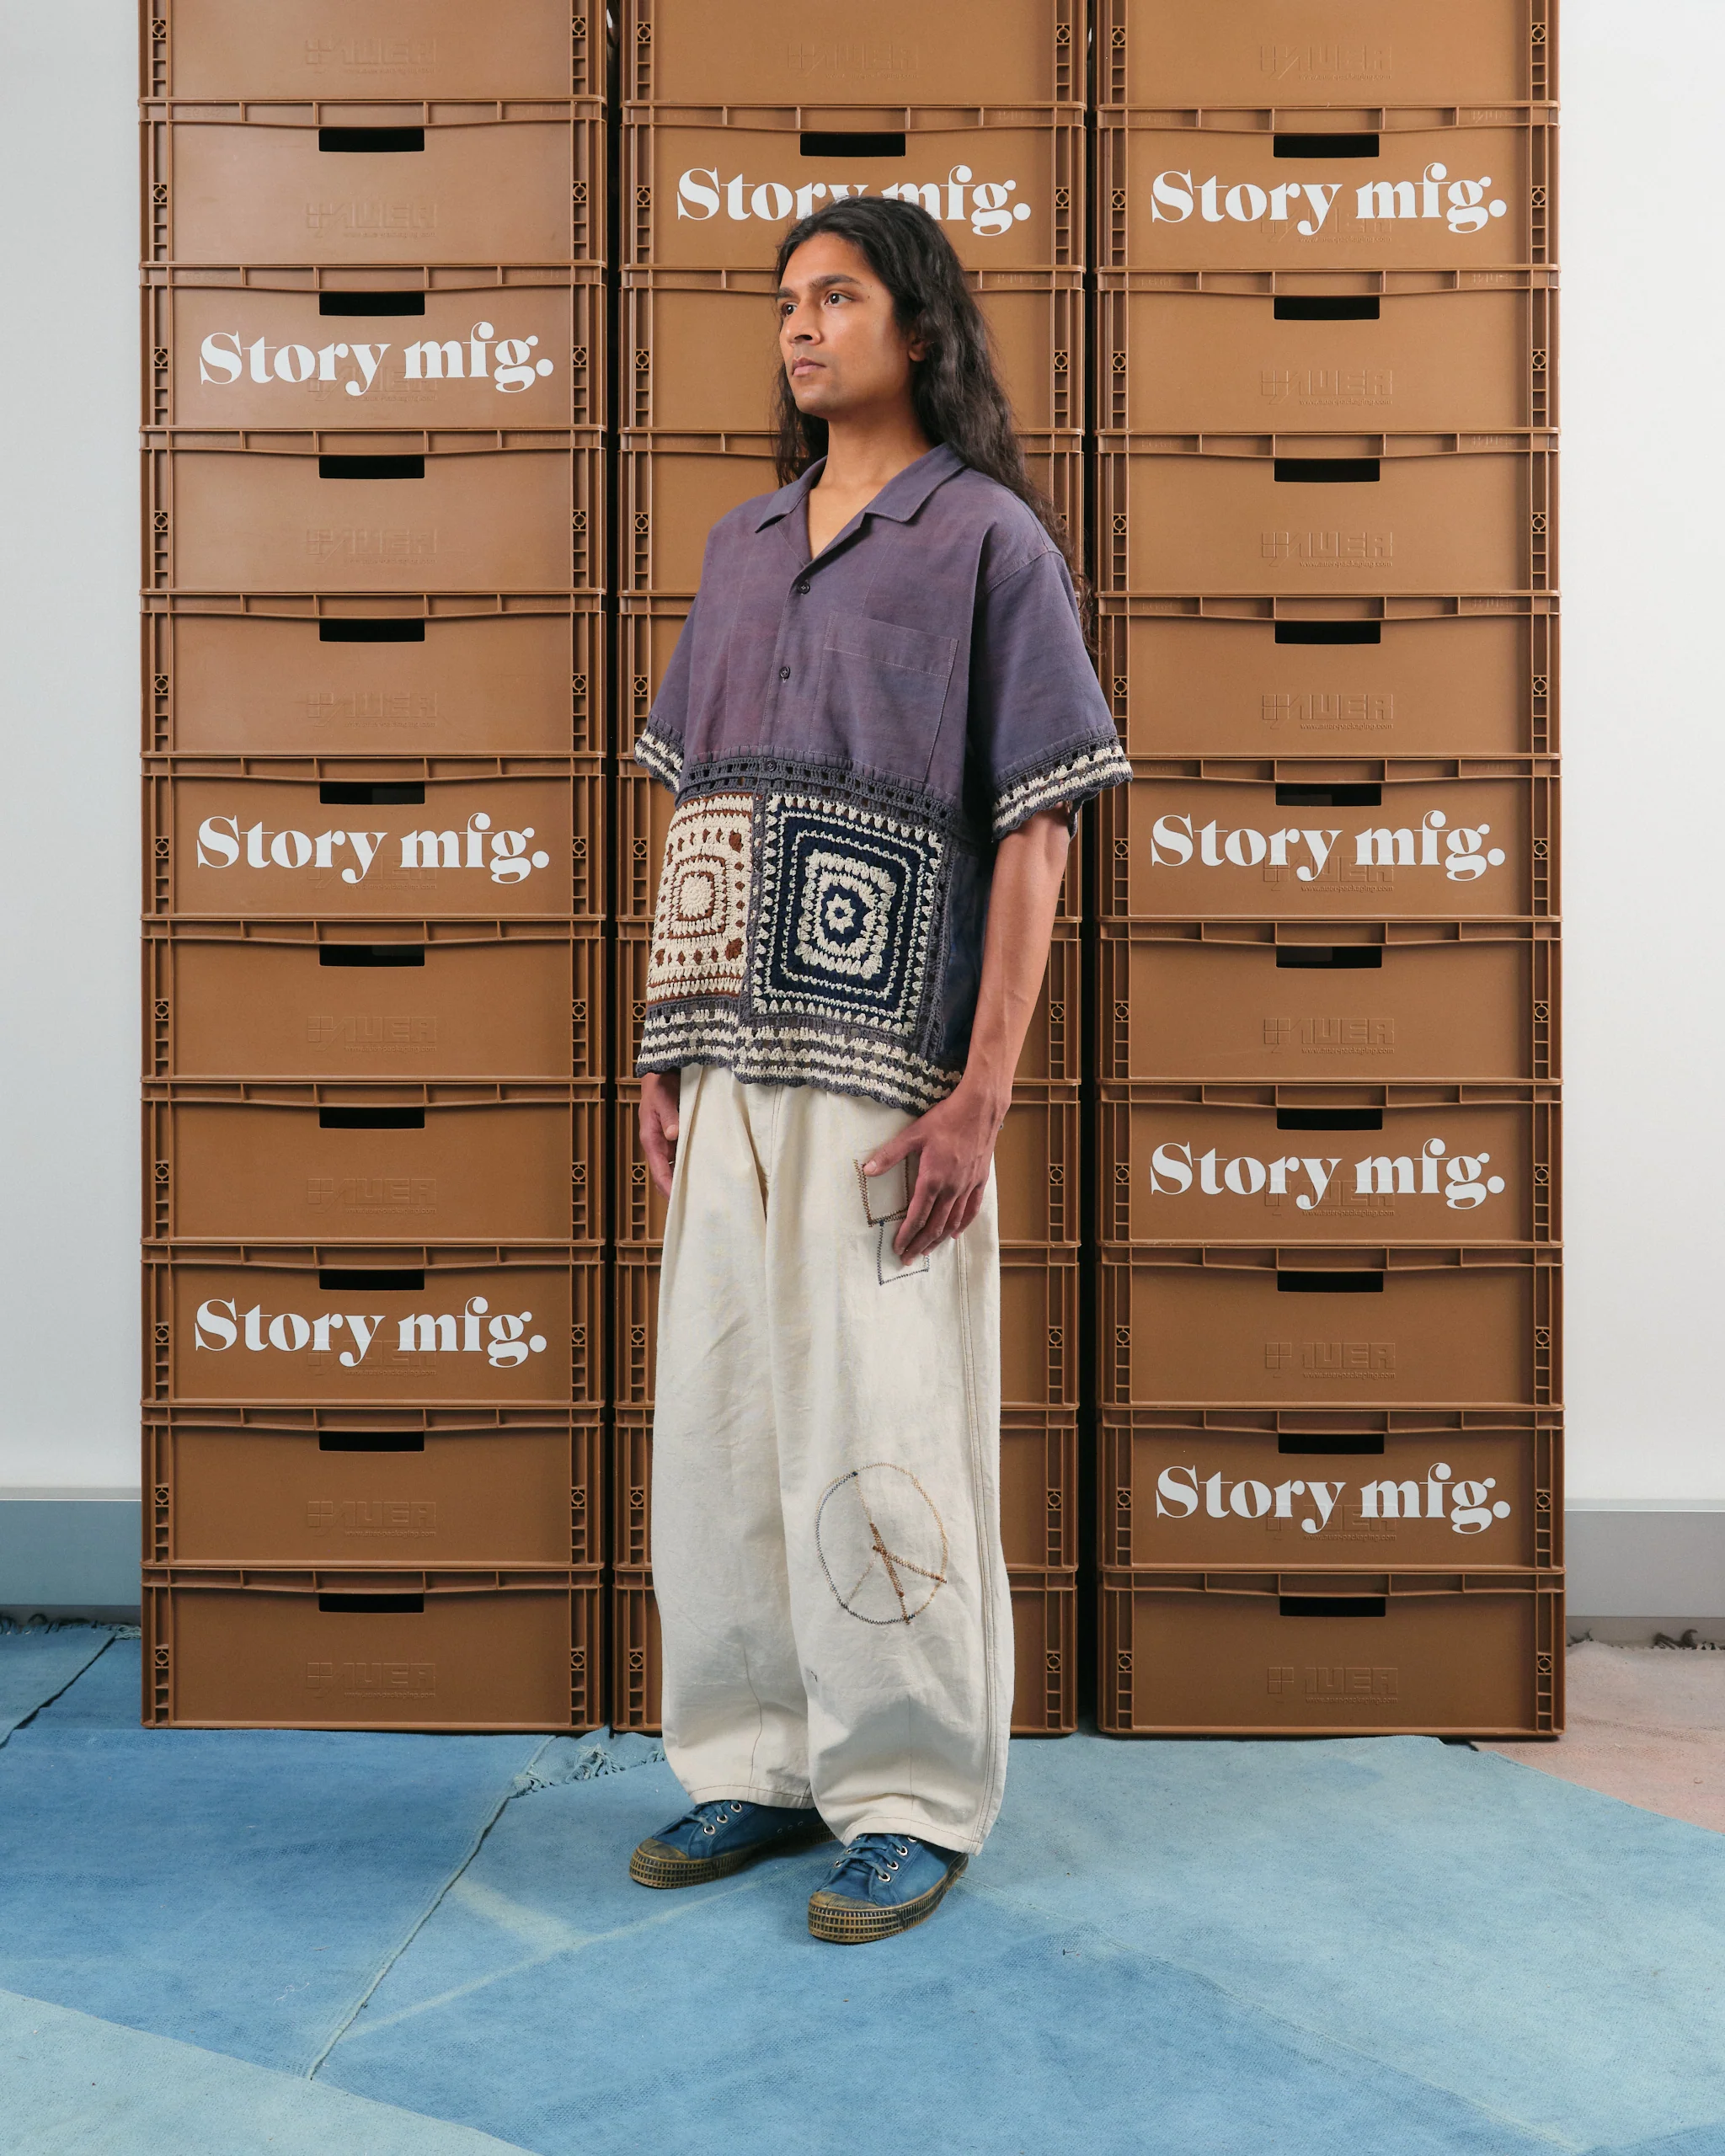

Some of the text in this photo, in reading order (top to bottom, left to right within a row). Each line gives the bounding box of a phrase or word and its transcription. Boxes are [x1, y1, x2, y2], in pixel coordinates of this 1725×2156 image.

[881, 164, 1031, 237] mfg.
[1151, 163, 1507, 236] Story mfg.
[200, 322, 553, 397] Story mfg.
[197, 813, 550, 884] Story mfg.
[1151, 810, 1505, 882] Story mfg.
[1151, 1139, 1505, 1210] Story mfg.
[195, 1297, 547, 1368] Story mfg.
[1156, 1463, 1511, 1534] Story mfg.
